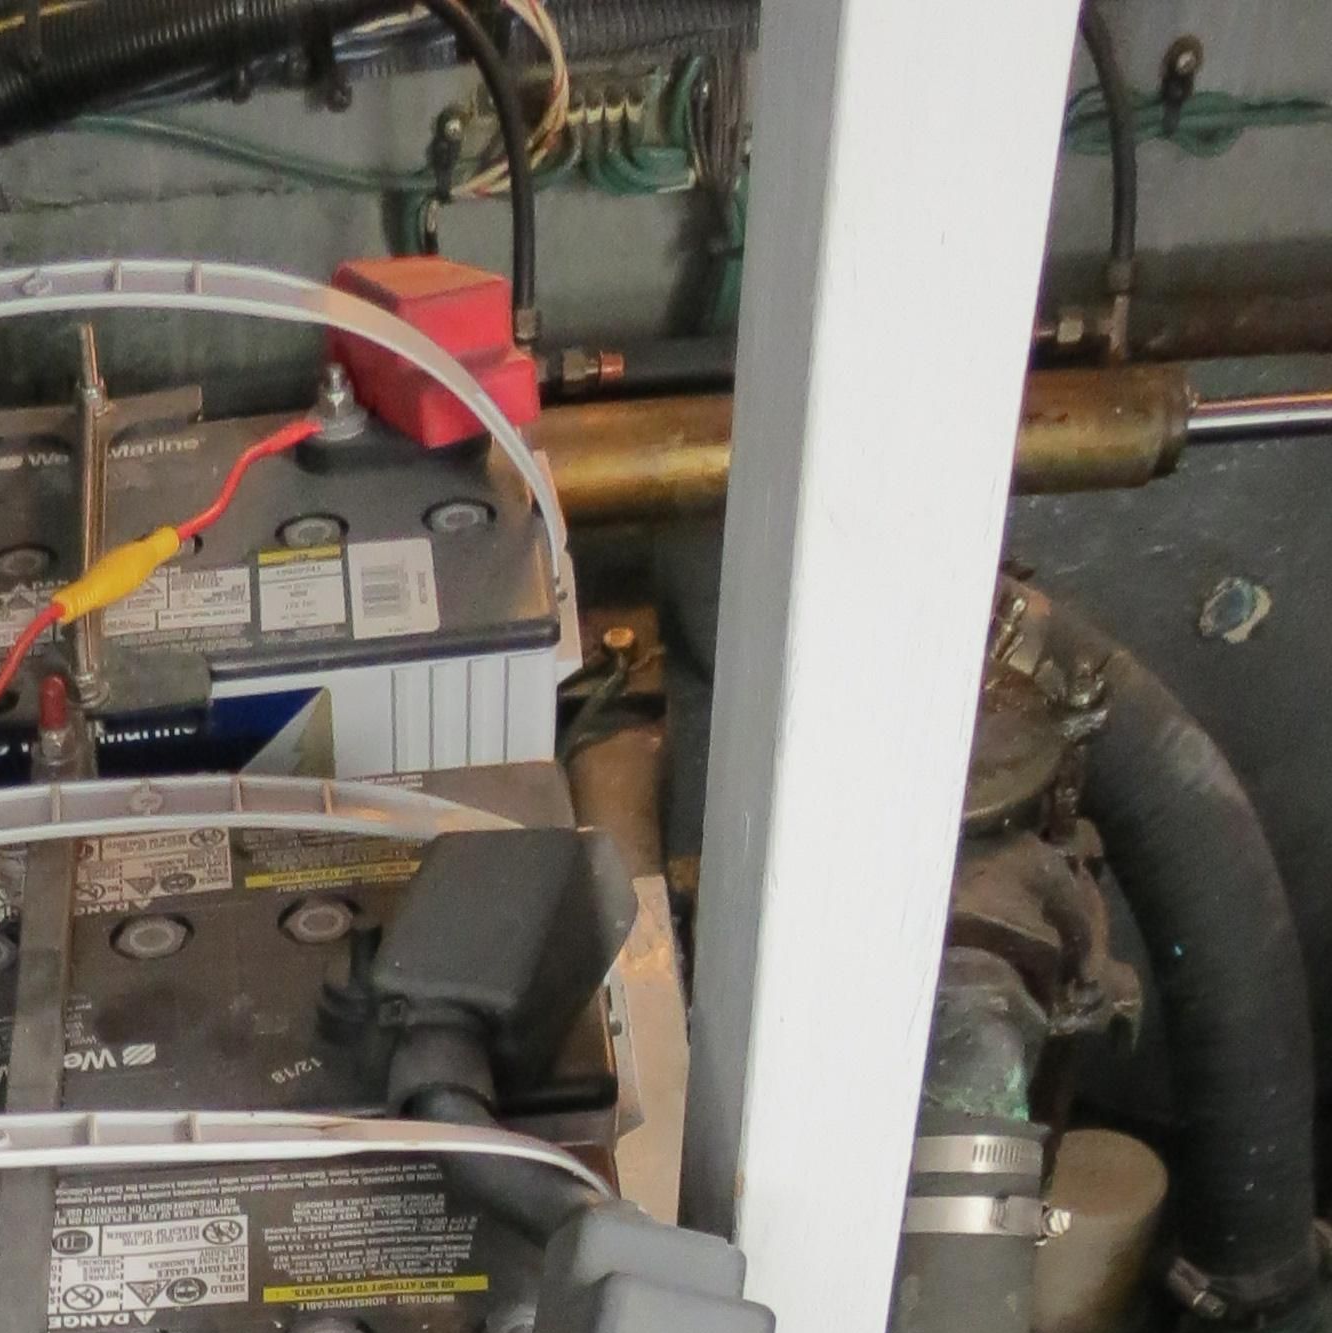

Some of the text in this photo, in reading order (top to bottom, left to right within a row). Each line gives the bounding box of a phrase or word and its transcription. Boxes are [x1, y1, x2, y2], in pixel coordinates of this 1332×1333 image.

[270, 1056, 322, 1086] 12/18
[156, 1263, 245, 1277] EXPLOSIVE GASES
